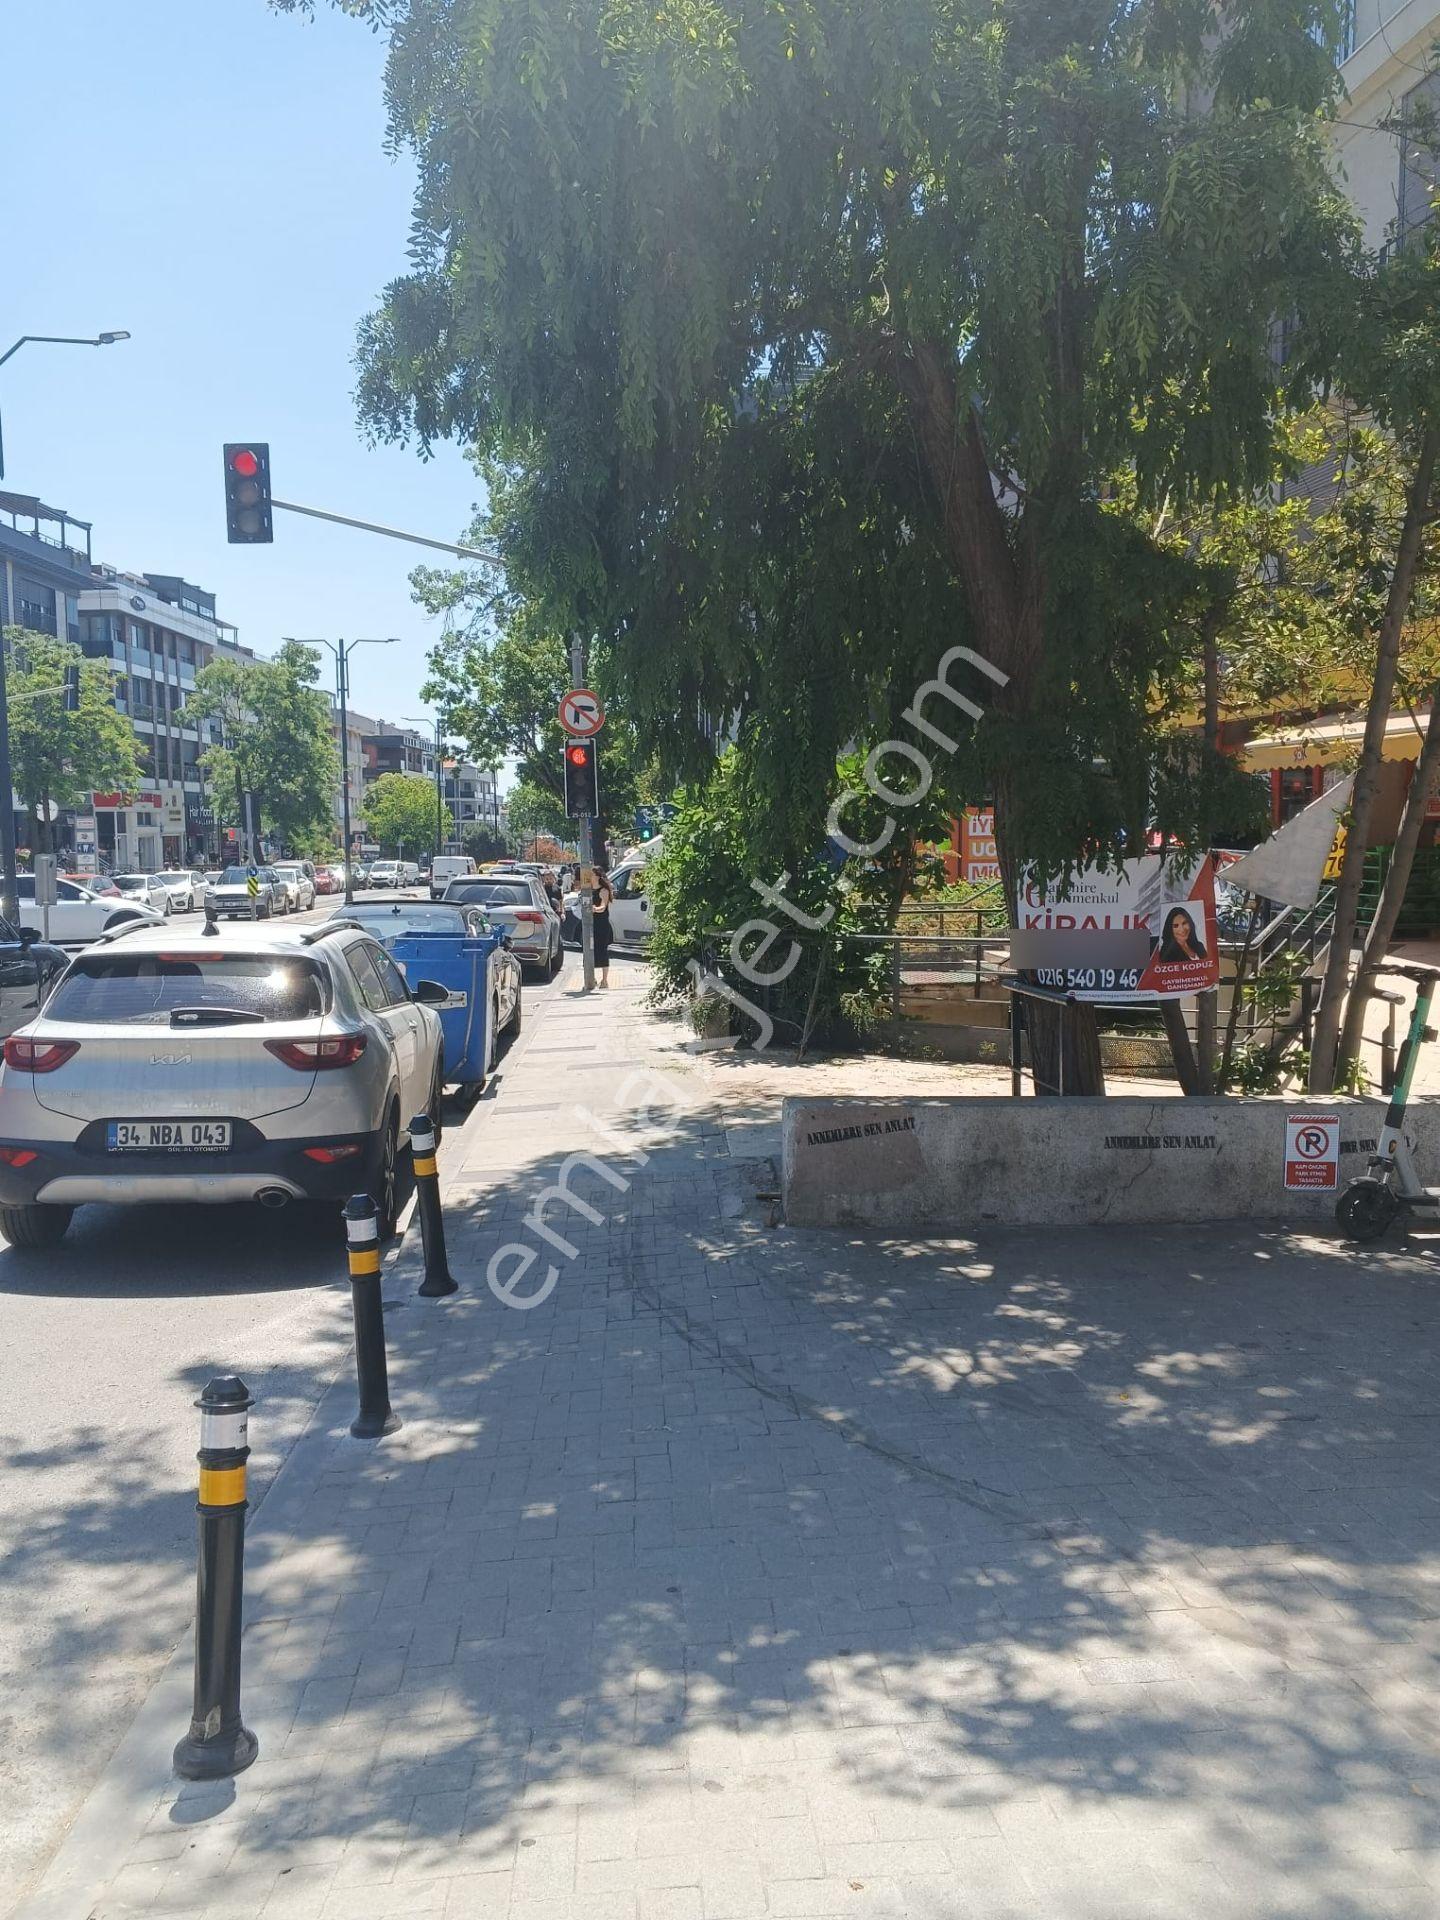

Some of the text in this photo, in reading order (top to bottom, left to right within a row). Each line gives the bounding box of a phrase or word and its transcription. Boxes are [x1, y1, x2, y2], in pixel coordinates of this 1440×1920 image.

[1154, 960, 1215, 974] ÖZGE KOPUZ
[1037, 968, 1138, 988] 0216 540 19 46
[118, 1124, 226, 1145] 34 NBA 043
